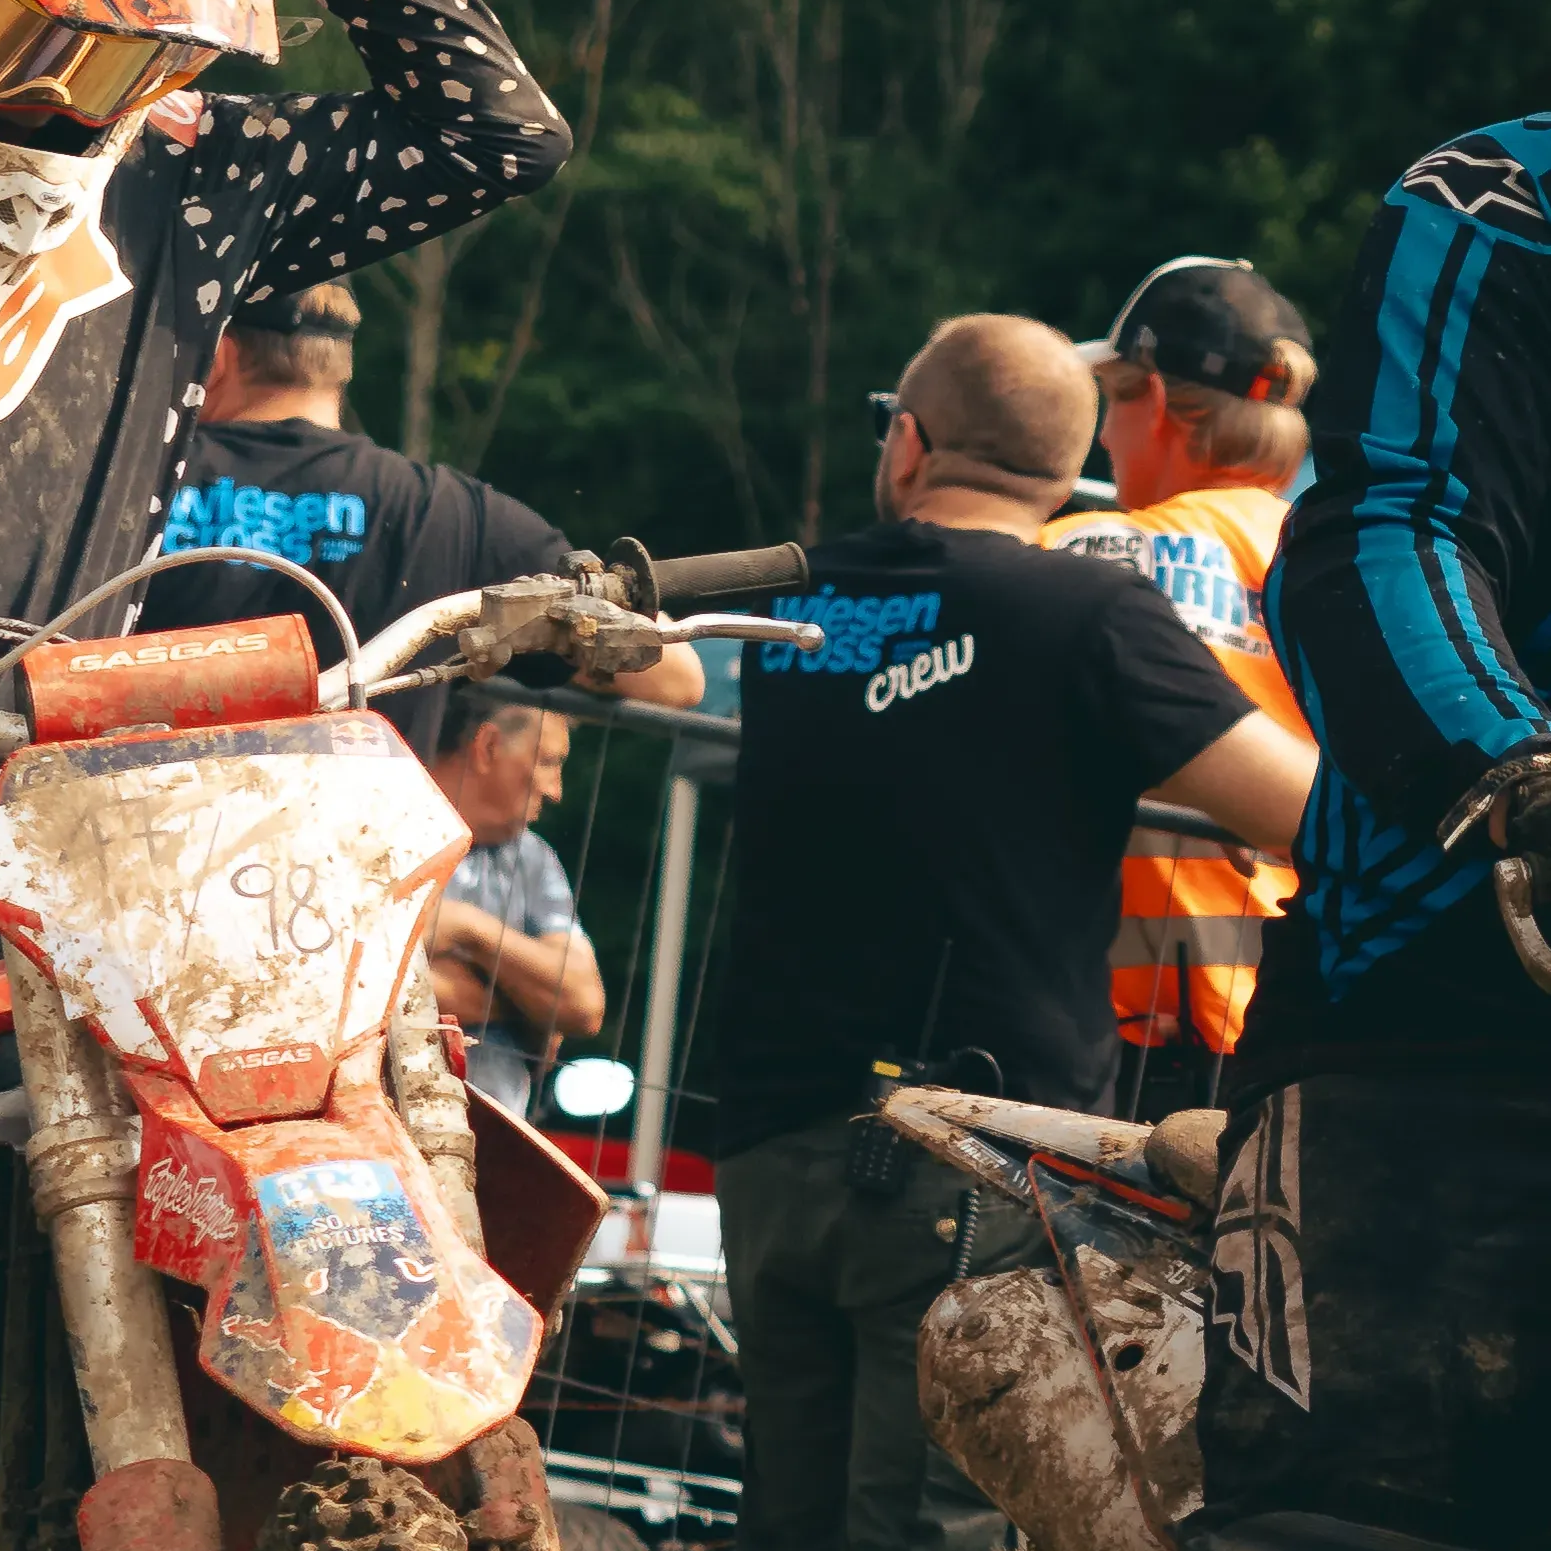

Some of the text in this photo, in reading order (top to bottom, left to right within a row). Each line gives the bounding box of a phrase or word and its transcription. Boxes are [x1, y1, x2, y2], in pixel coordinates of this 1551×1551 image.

[168, 476, 366, 537] wiesen
[162, 521, 312, 572] cross
[771, 583, 942, 637] wiesen
[67, 632, 270, 674] GASGAS
[761, 631, 884, 675] cross
[864, 632, 976, 714] crew
[229, 863, 335, 954] 98
